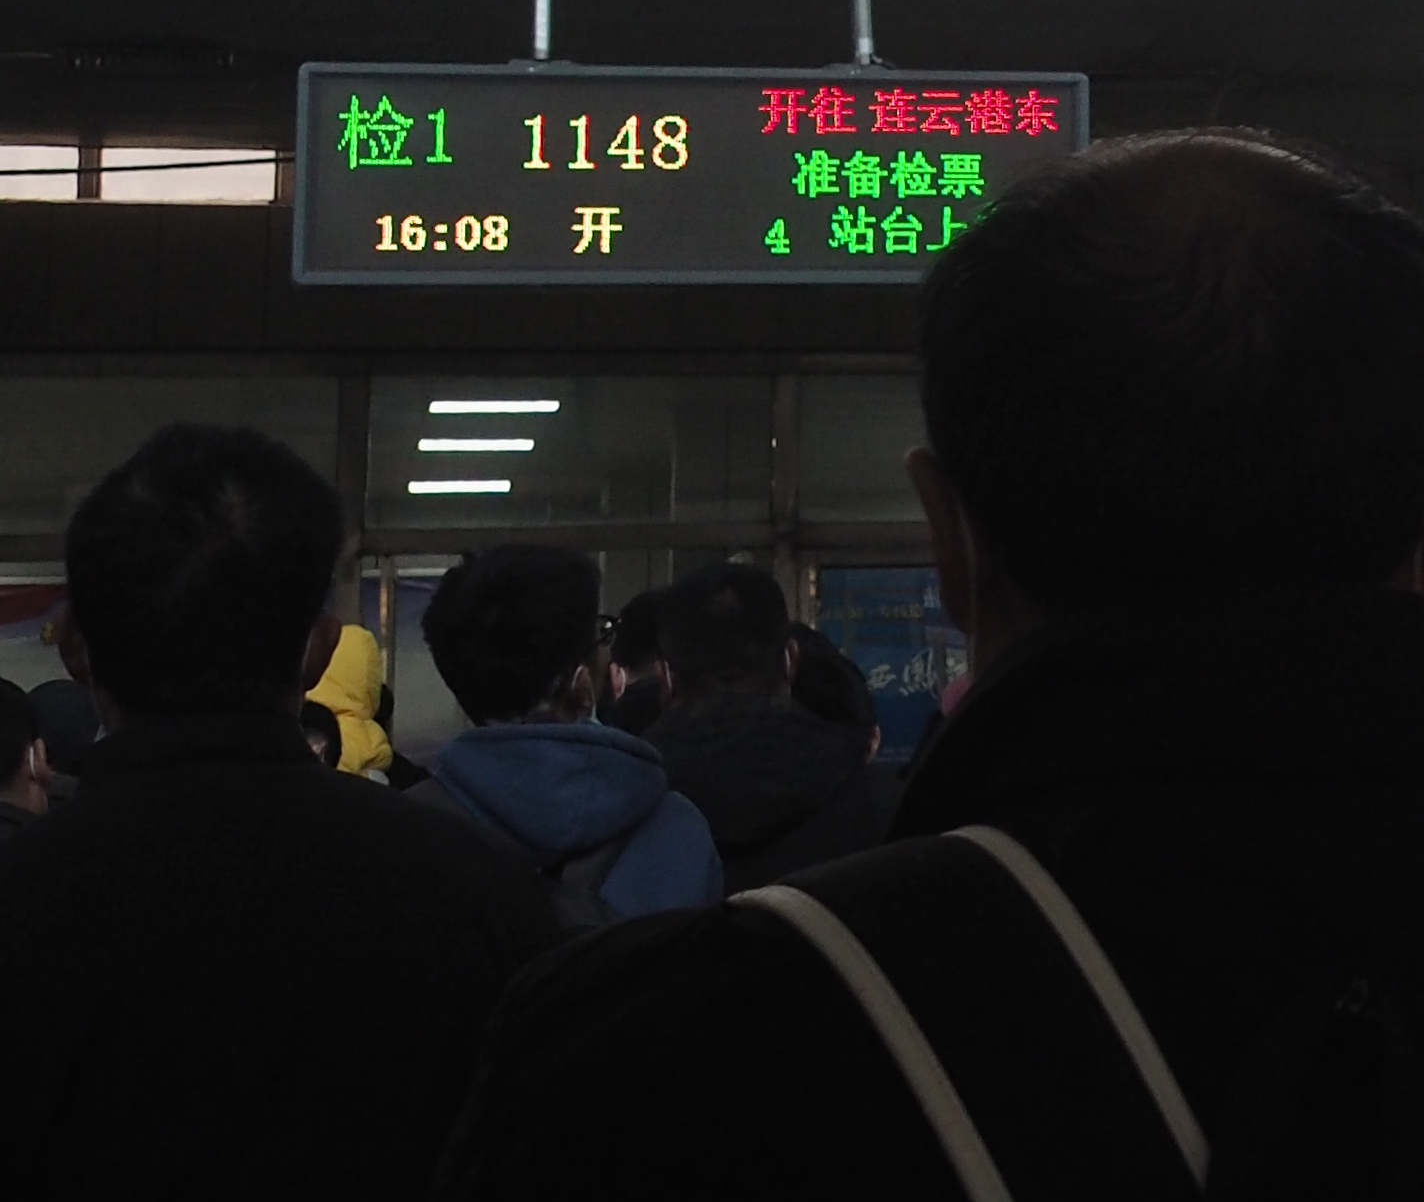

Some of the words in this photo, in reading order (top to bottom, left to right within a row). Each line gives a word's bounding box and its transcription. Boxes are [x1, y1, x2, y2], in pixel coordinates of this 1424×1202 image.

[337, 95, 453, 171] 检1
[524, 113, 690, 170] 1148
[758, 86, 858, 136] 开往
[868, 87, 1060, 138] 连云港东
[791, 148, 987, 201] 准备检票
[374, 214, 509, 251] 16:08
[571, 206, 623, 255] 开
[763, 216, 792, 255] 4
